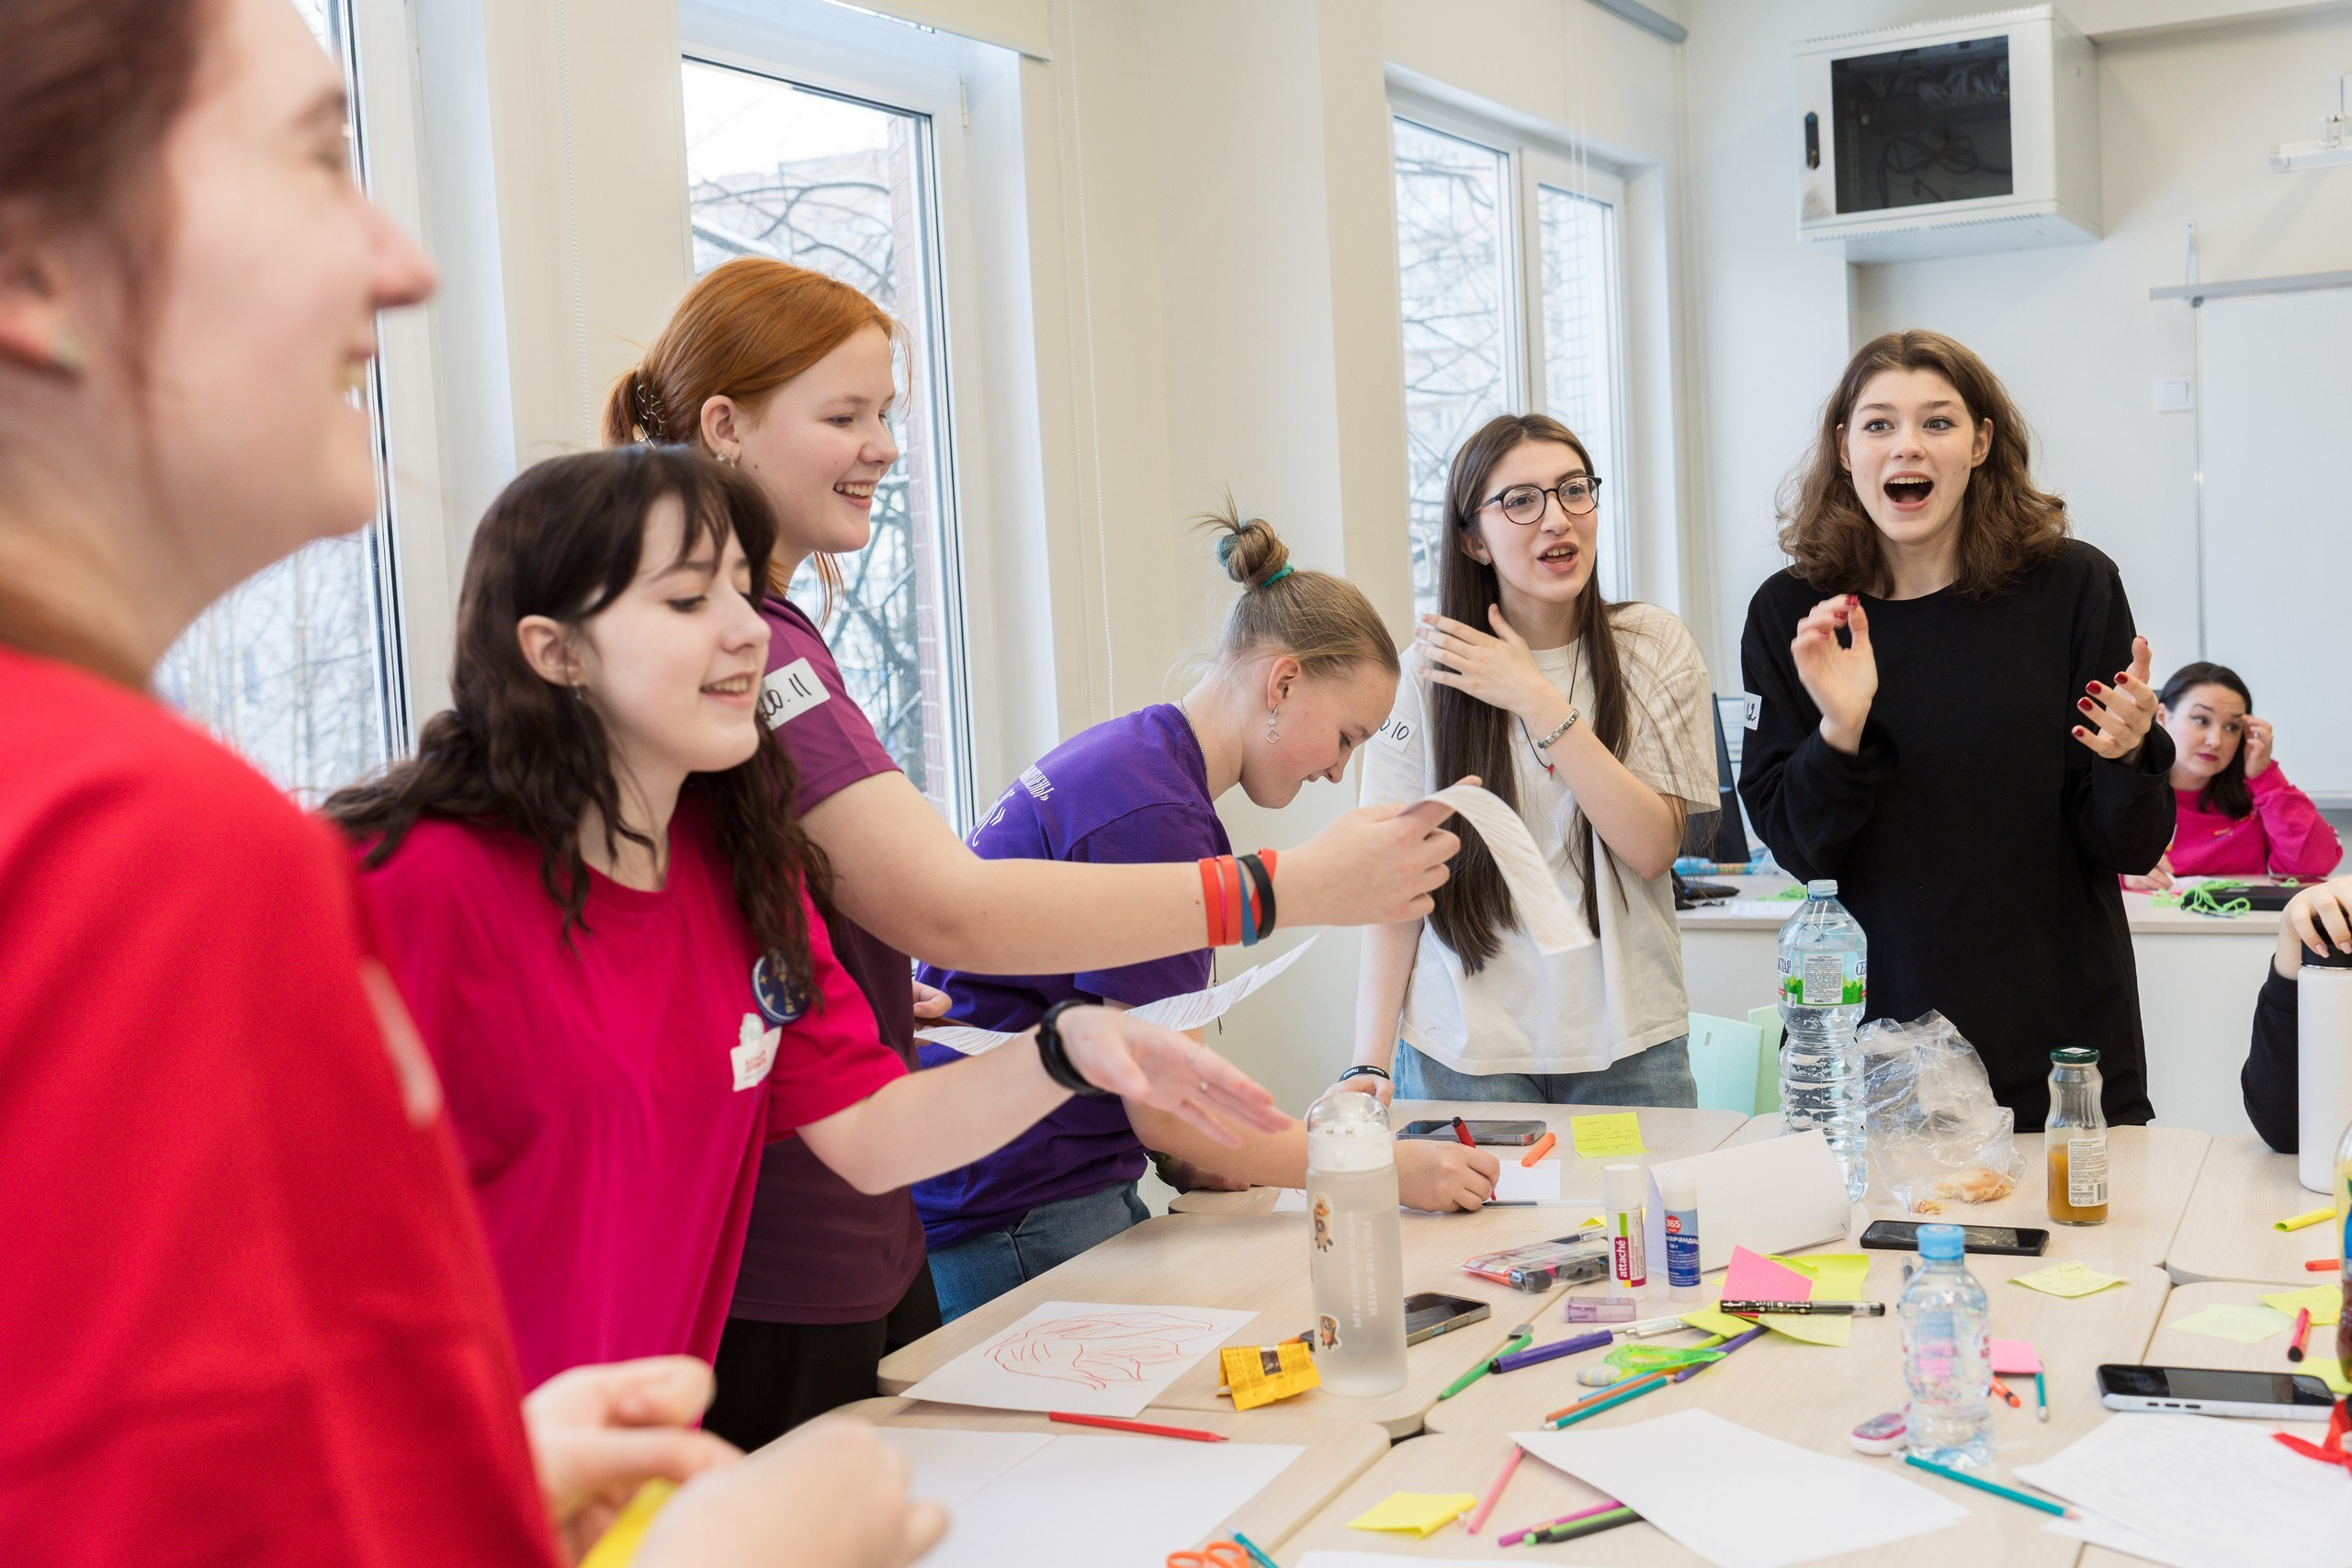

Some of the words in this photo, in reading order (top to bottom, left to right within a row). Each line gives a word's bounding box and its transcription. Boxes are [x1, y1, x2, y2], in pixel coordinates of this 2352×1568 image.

[1363, 1221, 1374, 1250] FEEL
[1666, 1219, 1681, 1229] 365
[1365, 1252, 1375, 1274] THE
[1616, 1239, 1628, 1278] attaché
[1366, 1276, 1378, 1317] WATER
